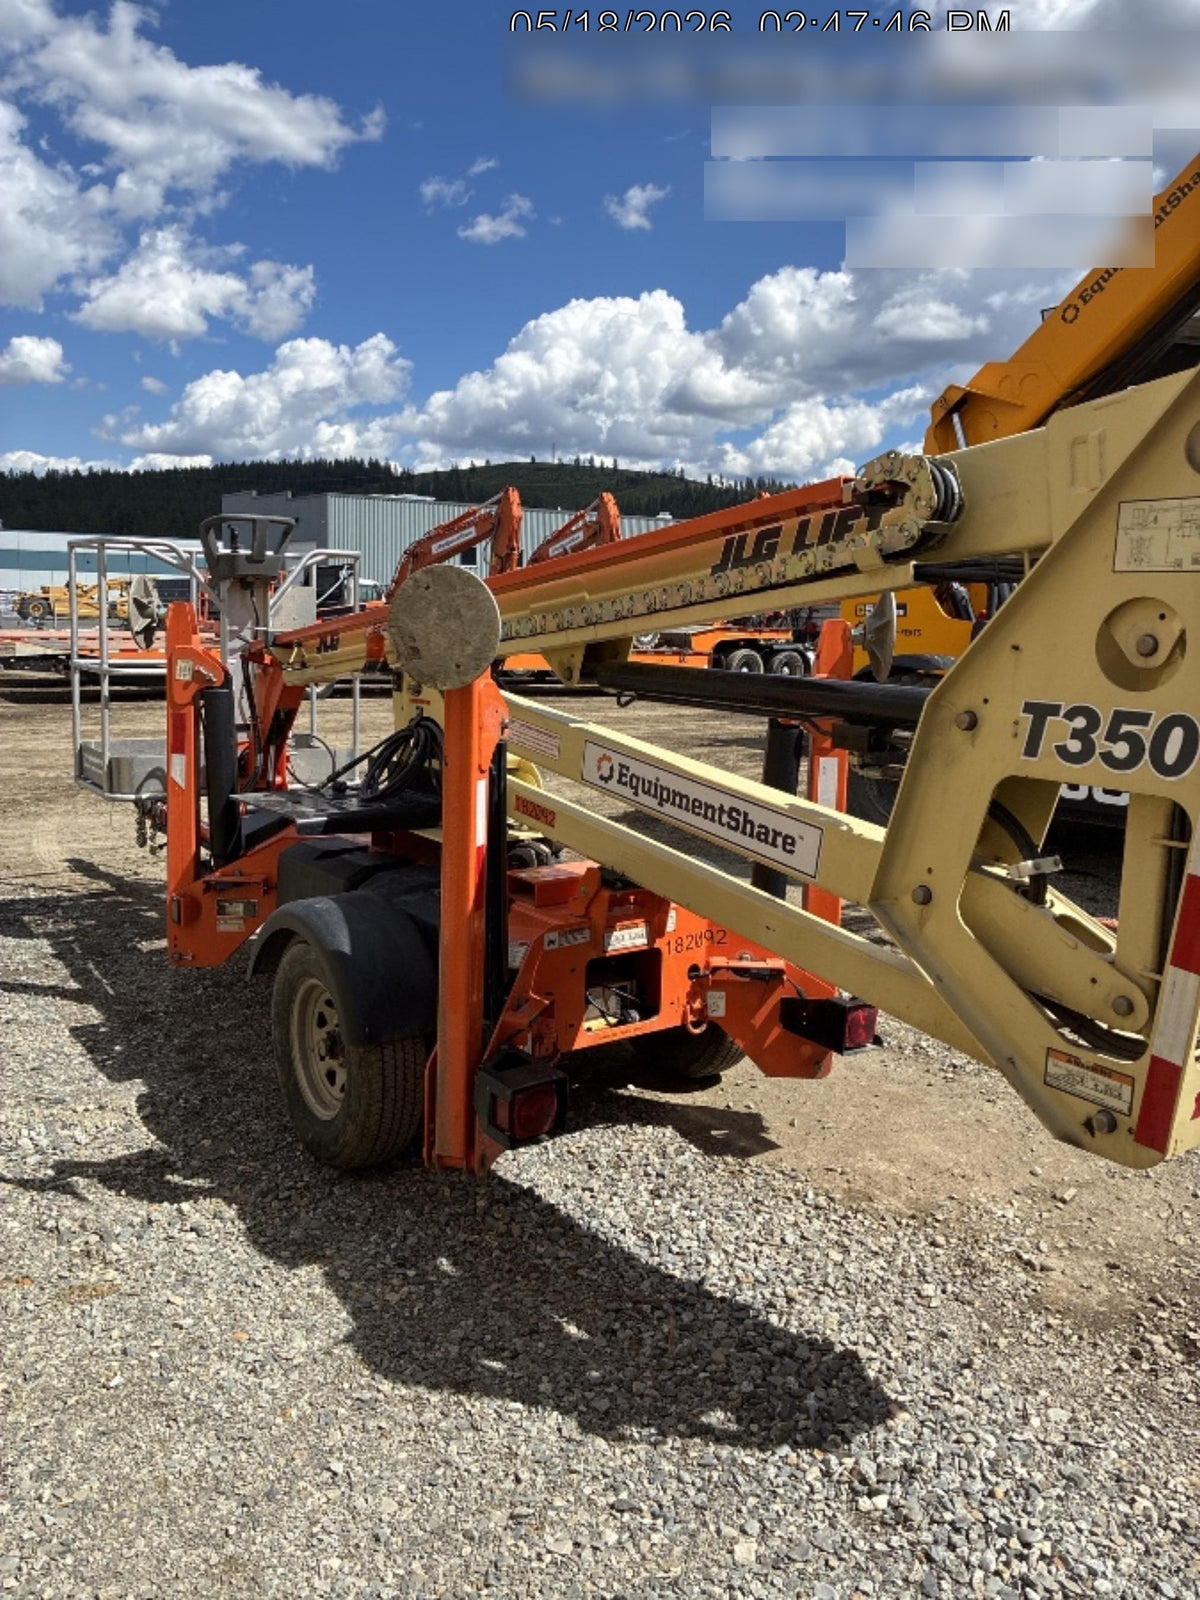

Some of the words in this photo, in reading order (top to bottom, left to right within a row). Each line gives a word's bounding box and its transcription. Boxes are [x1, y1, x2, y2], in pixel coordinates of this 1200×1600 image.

[711, 524, 783, 575] JLG
[1020, 700, 1200, 781] T350
[616, 762, 797, 855] EquipmentShare
[665, 928, 727, 955] 182092
